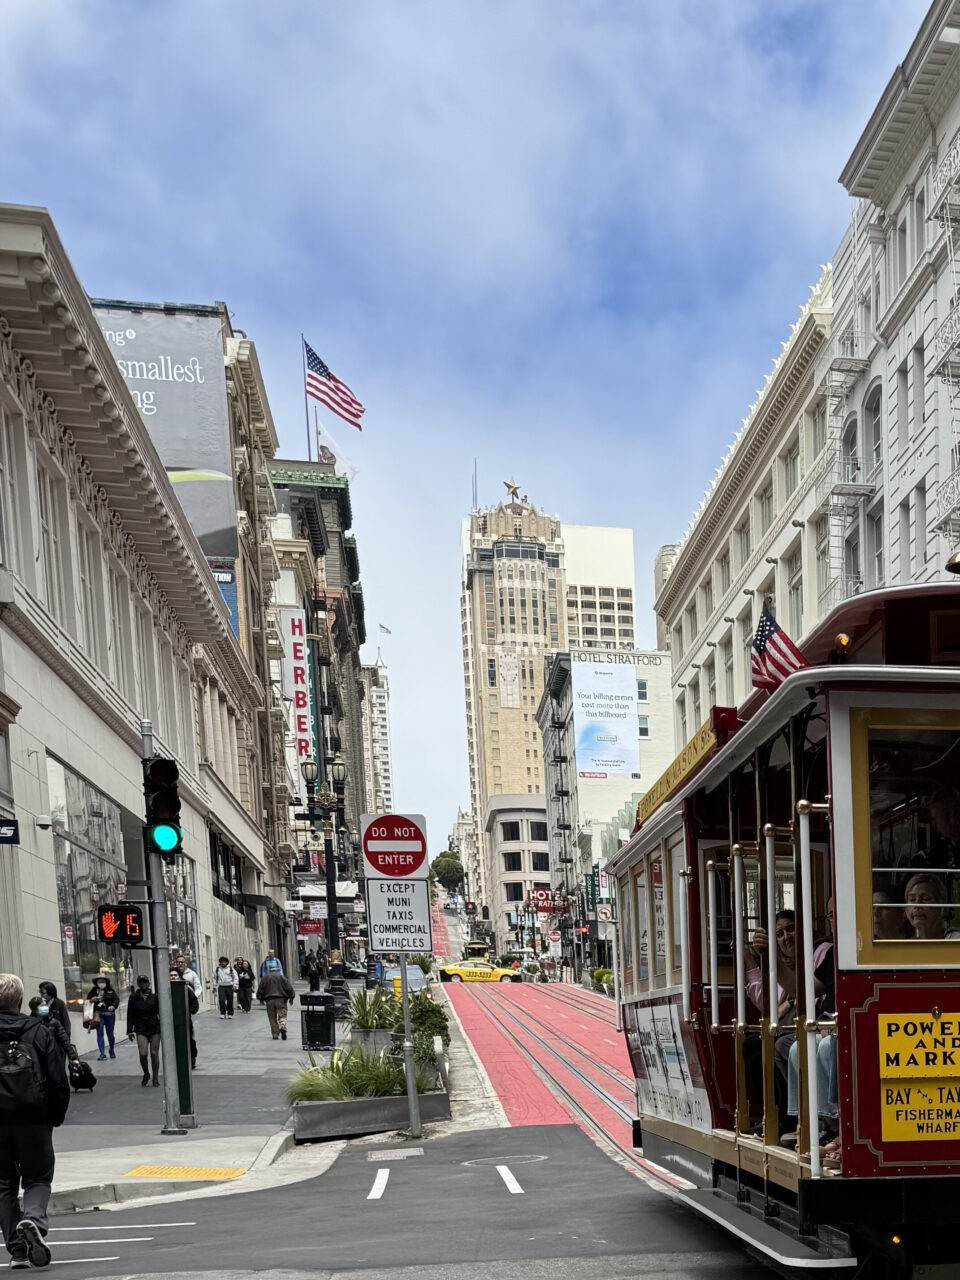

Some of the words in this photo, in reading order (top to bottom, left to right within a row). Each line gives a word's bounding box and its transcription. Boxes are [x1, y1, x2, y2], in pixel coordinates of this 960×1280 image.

[117, 355, 205, 384] smallest
[572, 652, 605, 663] HOTEL
[606, 654, 662, 666] STRATFORD
[290, 618, 311, 758] HERBER
[593, 693, 614, 702] billing
[614, 702, 630, 710] than
[585, 710, 598, 718] this
[598, 710, 627, 719] billboard
[672, 737, 698, 783] MASON
[372, 827, 387, 837] DO
[394, 827, 416, 838] NOT
[378, 855, 414, 865] ENTER
[380, 883, 416, 894] EXCEPT
[529, 890, 564, 901] HOTE
[387, 898, 411, 907] MUNI
[386, 910, 414, 921] TAXIS
[126, 914, 140, 936] 15
[373, 924, 429, 934] COMMERCIAL
[379, 938, 425, 948] VEHICLES
[886, 1088, 912, 1105] BAY
[917, 1089, 934, 1104] AND
[916, 1122, 960, 1134] WHARF
